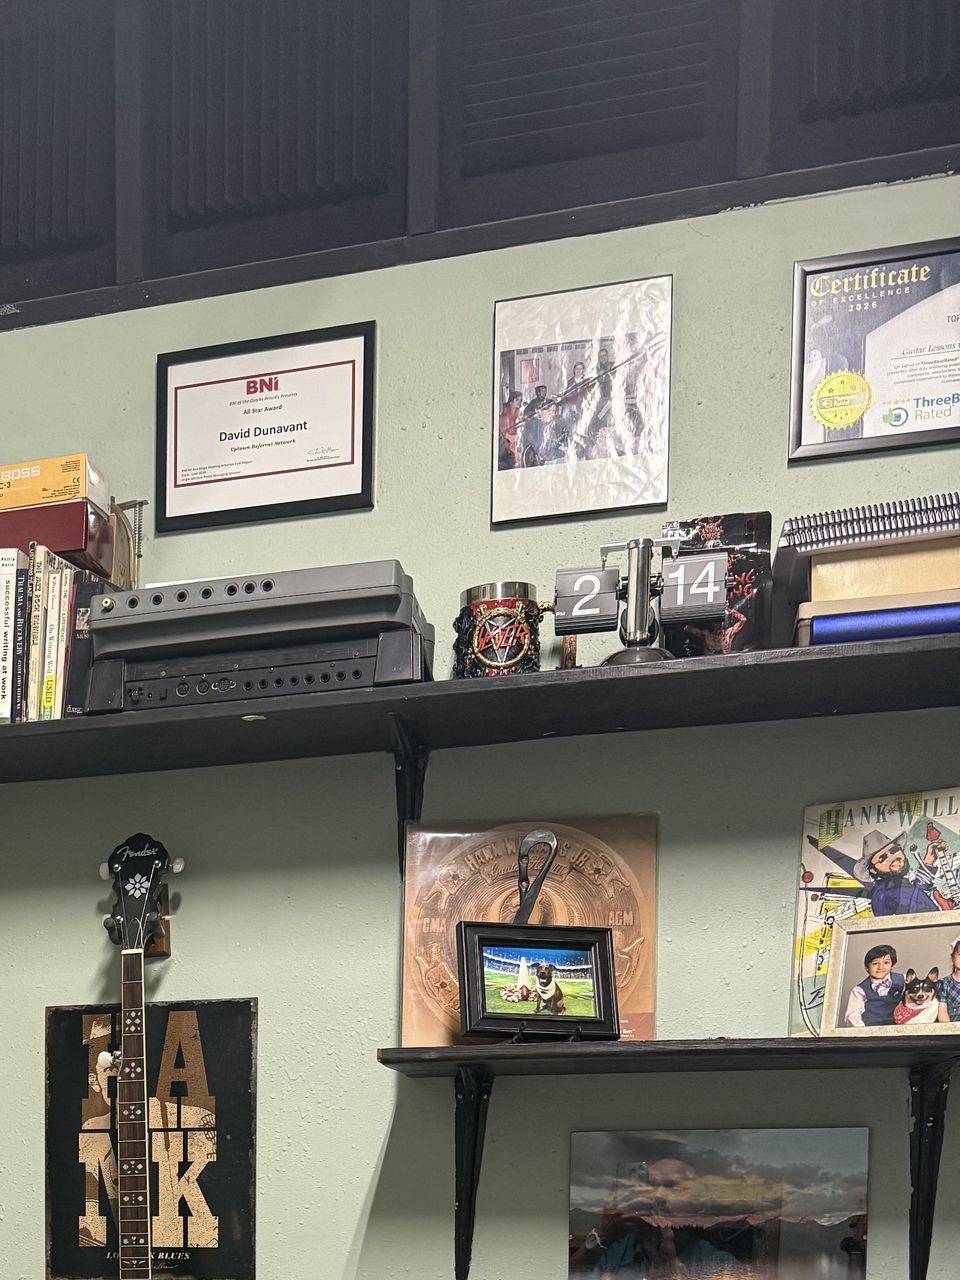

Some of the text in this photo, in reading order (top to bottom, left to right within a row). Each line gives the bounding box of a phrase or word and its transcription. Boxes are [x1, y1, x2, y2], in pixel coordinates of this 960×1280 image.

[809, 263, 931, 298] Certificate
[811, 286, 911, 307] OF EXCELLENCE
[848, 301, 878, 312] 2026
[928, 342, 956, 354] Lessons
[252, 406, 263, 415] Star
[264, 404, 282, 413] Award
[913, 392, 960, 408] ThreeB
[914, 406, 952, 421] Rated
[219, 421, 308, 442] David Dunavant
[274, 438, 296, 446] Network
[1, 466, 41, 480] BOSS
[668, 561, 721, 606] 14
[571, 574, 601, 617] 2
[16, 575, 25, 656] TRAUMA RECOVERY
[48, 624, 55, 634] On
[477, 624, 529, 651] SLAYER
[1, 631, 9, 662] writing
[46, 636, 54, 661] Writing
[1, 665, 8, 675] at
[45, 679, 53, 703] USED
[824, 796, 960, 837] HANK WILL
[117, 844, 159, 860] Fender
[463, 843, 501, 872] HANK
[157, 1251, 191, 1260] BLUES
